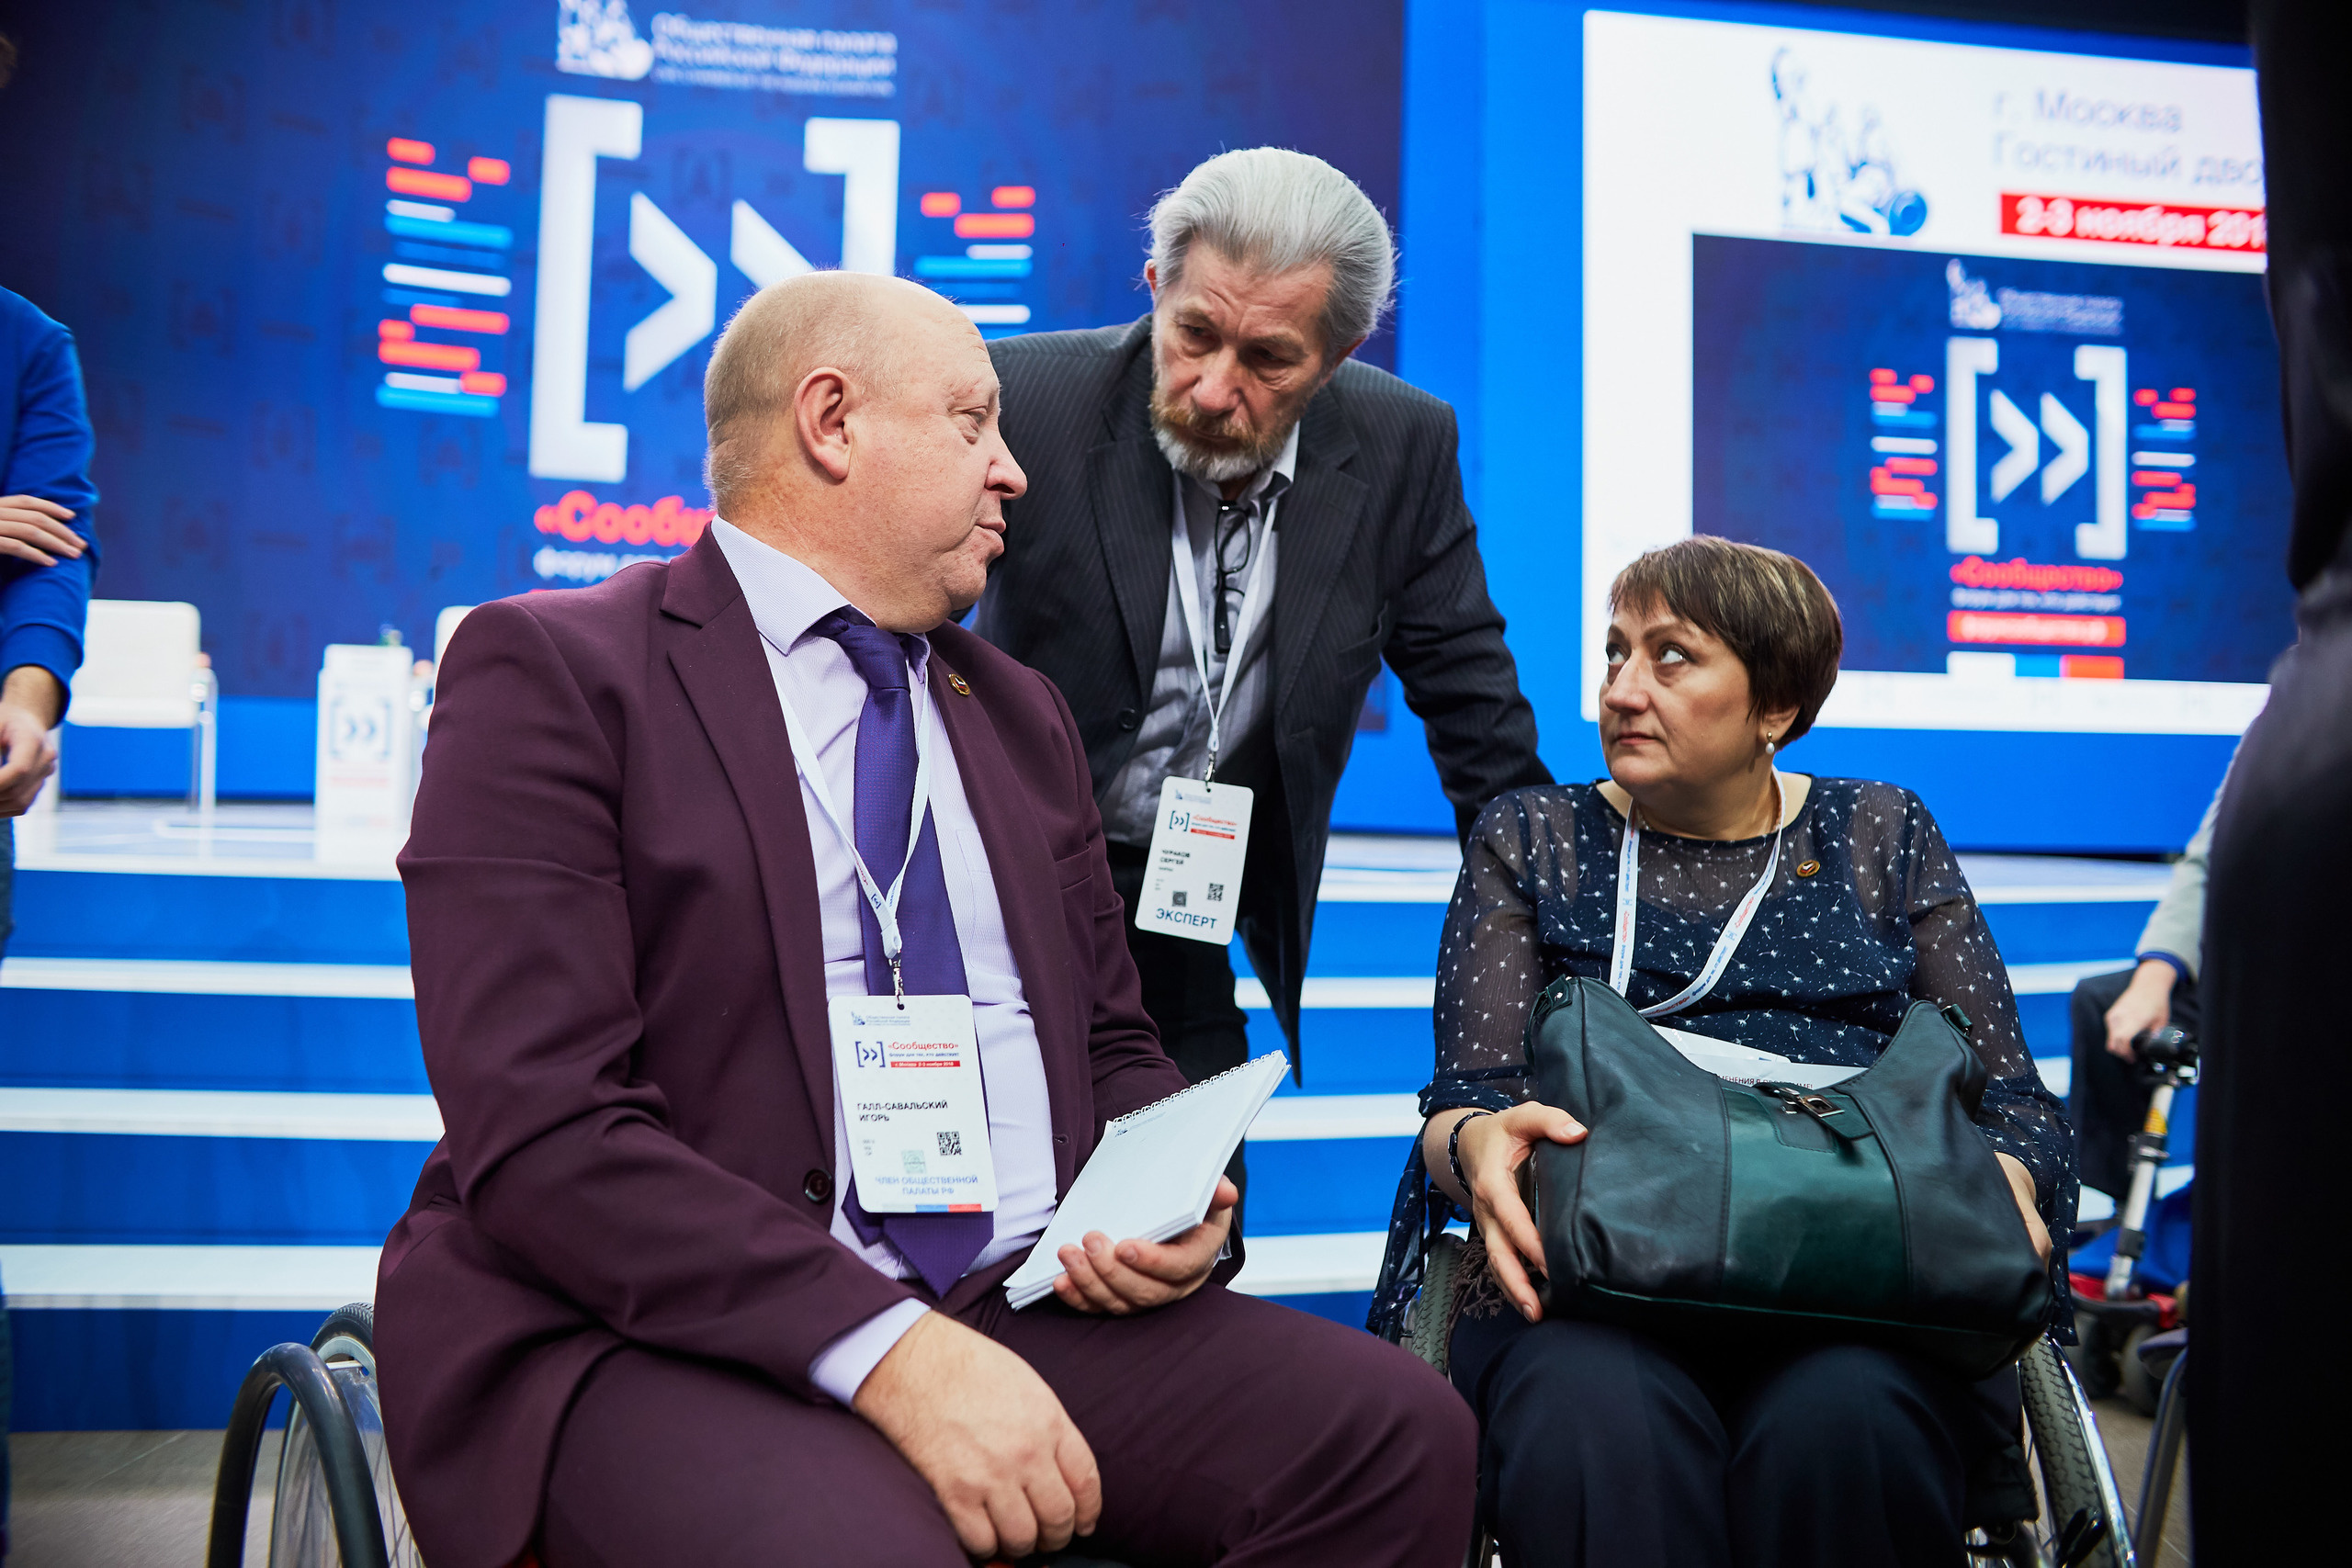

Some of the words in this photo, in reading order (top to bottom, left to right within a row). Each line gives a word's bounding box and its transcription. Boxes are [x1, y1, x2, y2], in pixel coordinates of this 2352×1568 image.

[2035, 88, 2183, 133] Москва
[1994, 130, 2182, 177] Гостиный
[2192, 154, 2264, 186] дво
[2016, 196, 2074, 236] 2-3
[2075, 205, 2206, 245] ноября
[2207, 210, 2265, 248] 201
[1156, 908, 1217, 929] ЭКСПЕРТ
[888, 1041, 959, 1050] «Сообщество»
[857, 1100, 948, 1111] ГАЛЛ-САВАЛЬСКИЙ
[875, 1177, 899, 1185] ЧЛЕН
[901, 1175, 978, 1185] ОБЩЕСТВЕННОЙ
